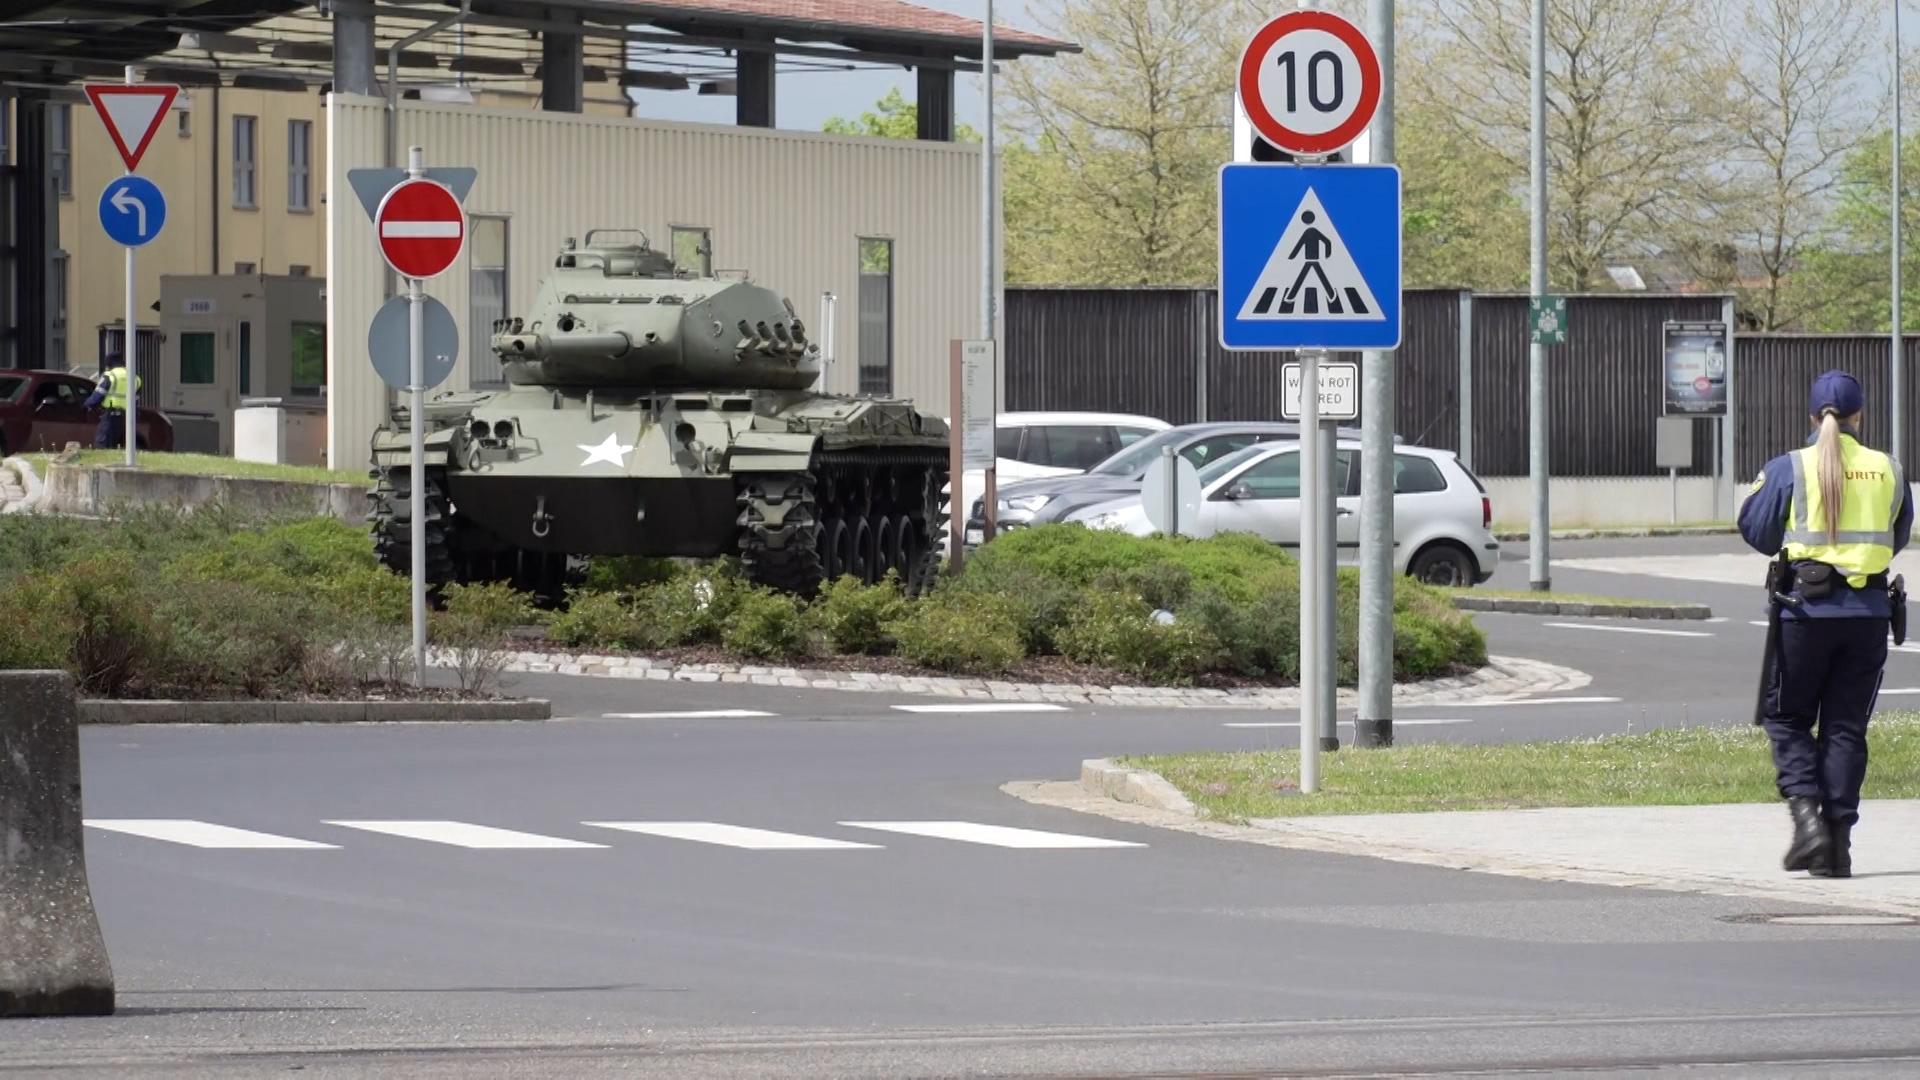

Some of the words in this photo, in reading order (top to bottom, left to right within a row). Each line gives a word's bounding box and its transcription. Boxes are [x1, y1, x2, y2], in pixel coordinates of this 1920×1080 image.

[1277, 50, 1344, 113] 10
[1288, 377, 1324, 388] WN
[1328, 377, 1351, 388] ROT
[1318, 393, 1342, 404] RED
[1845, 471, 1886, 482] URITY
